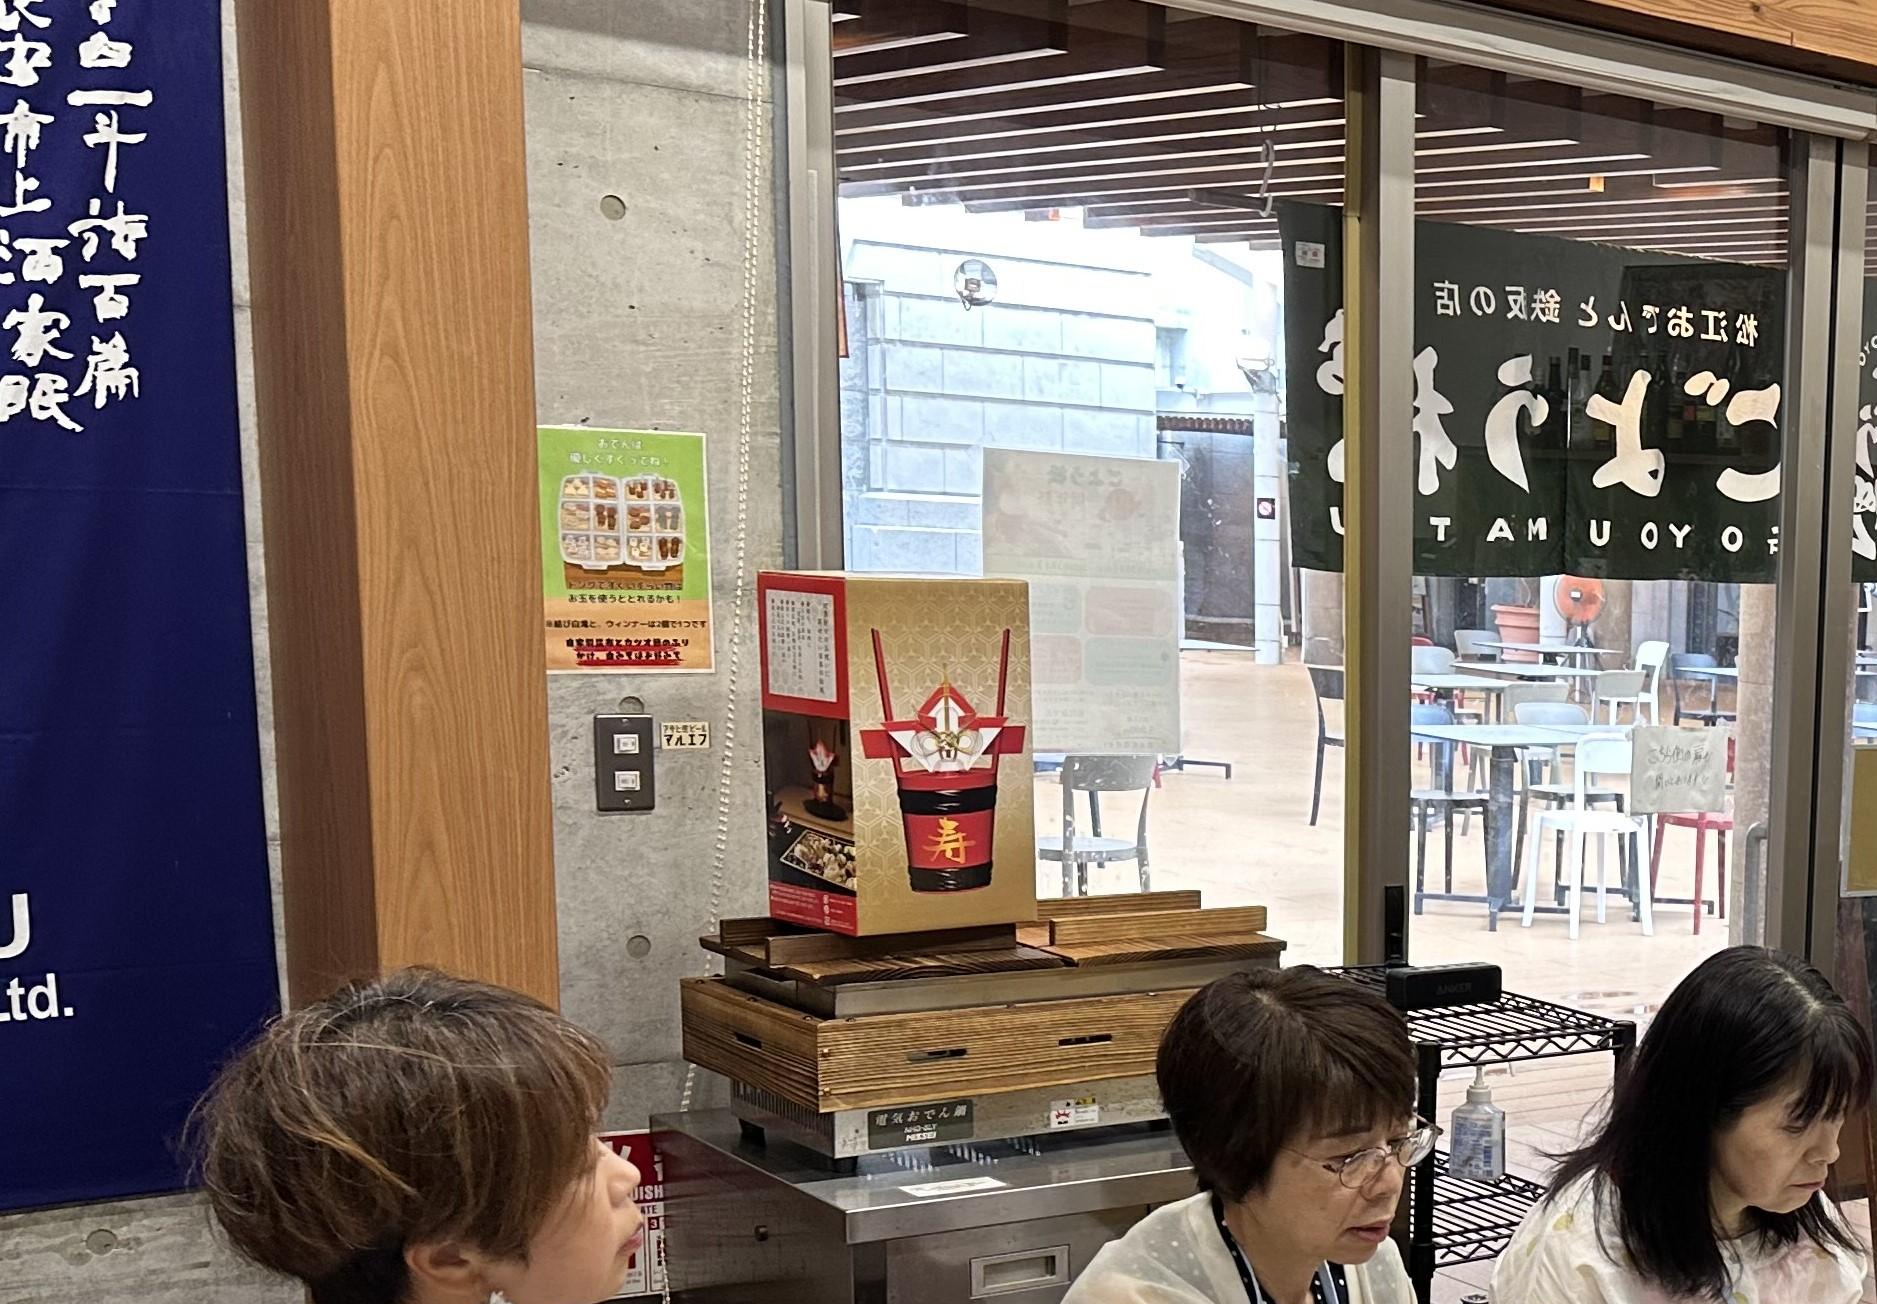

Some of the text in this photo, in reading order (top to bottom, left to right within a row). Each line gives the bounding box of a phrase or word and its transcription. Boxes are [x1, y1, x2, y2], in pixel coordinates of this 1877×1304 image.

[664, 734, 708, 747] マルエフ
[923, 816, 977, 864] 寿
